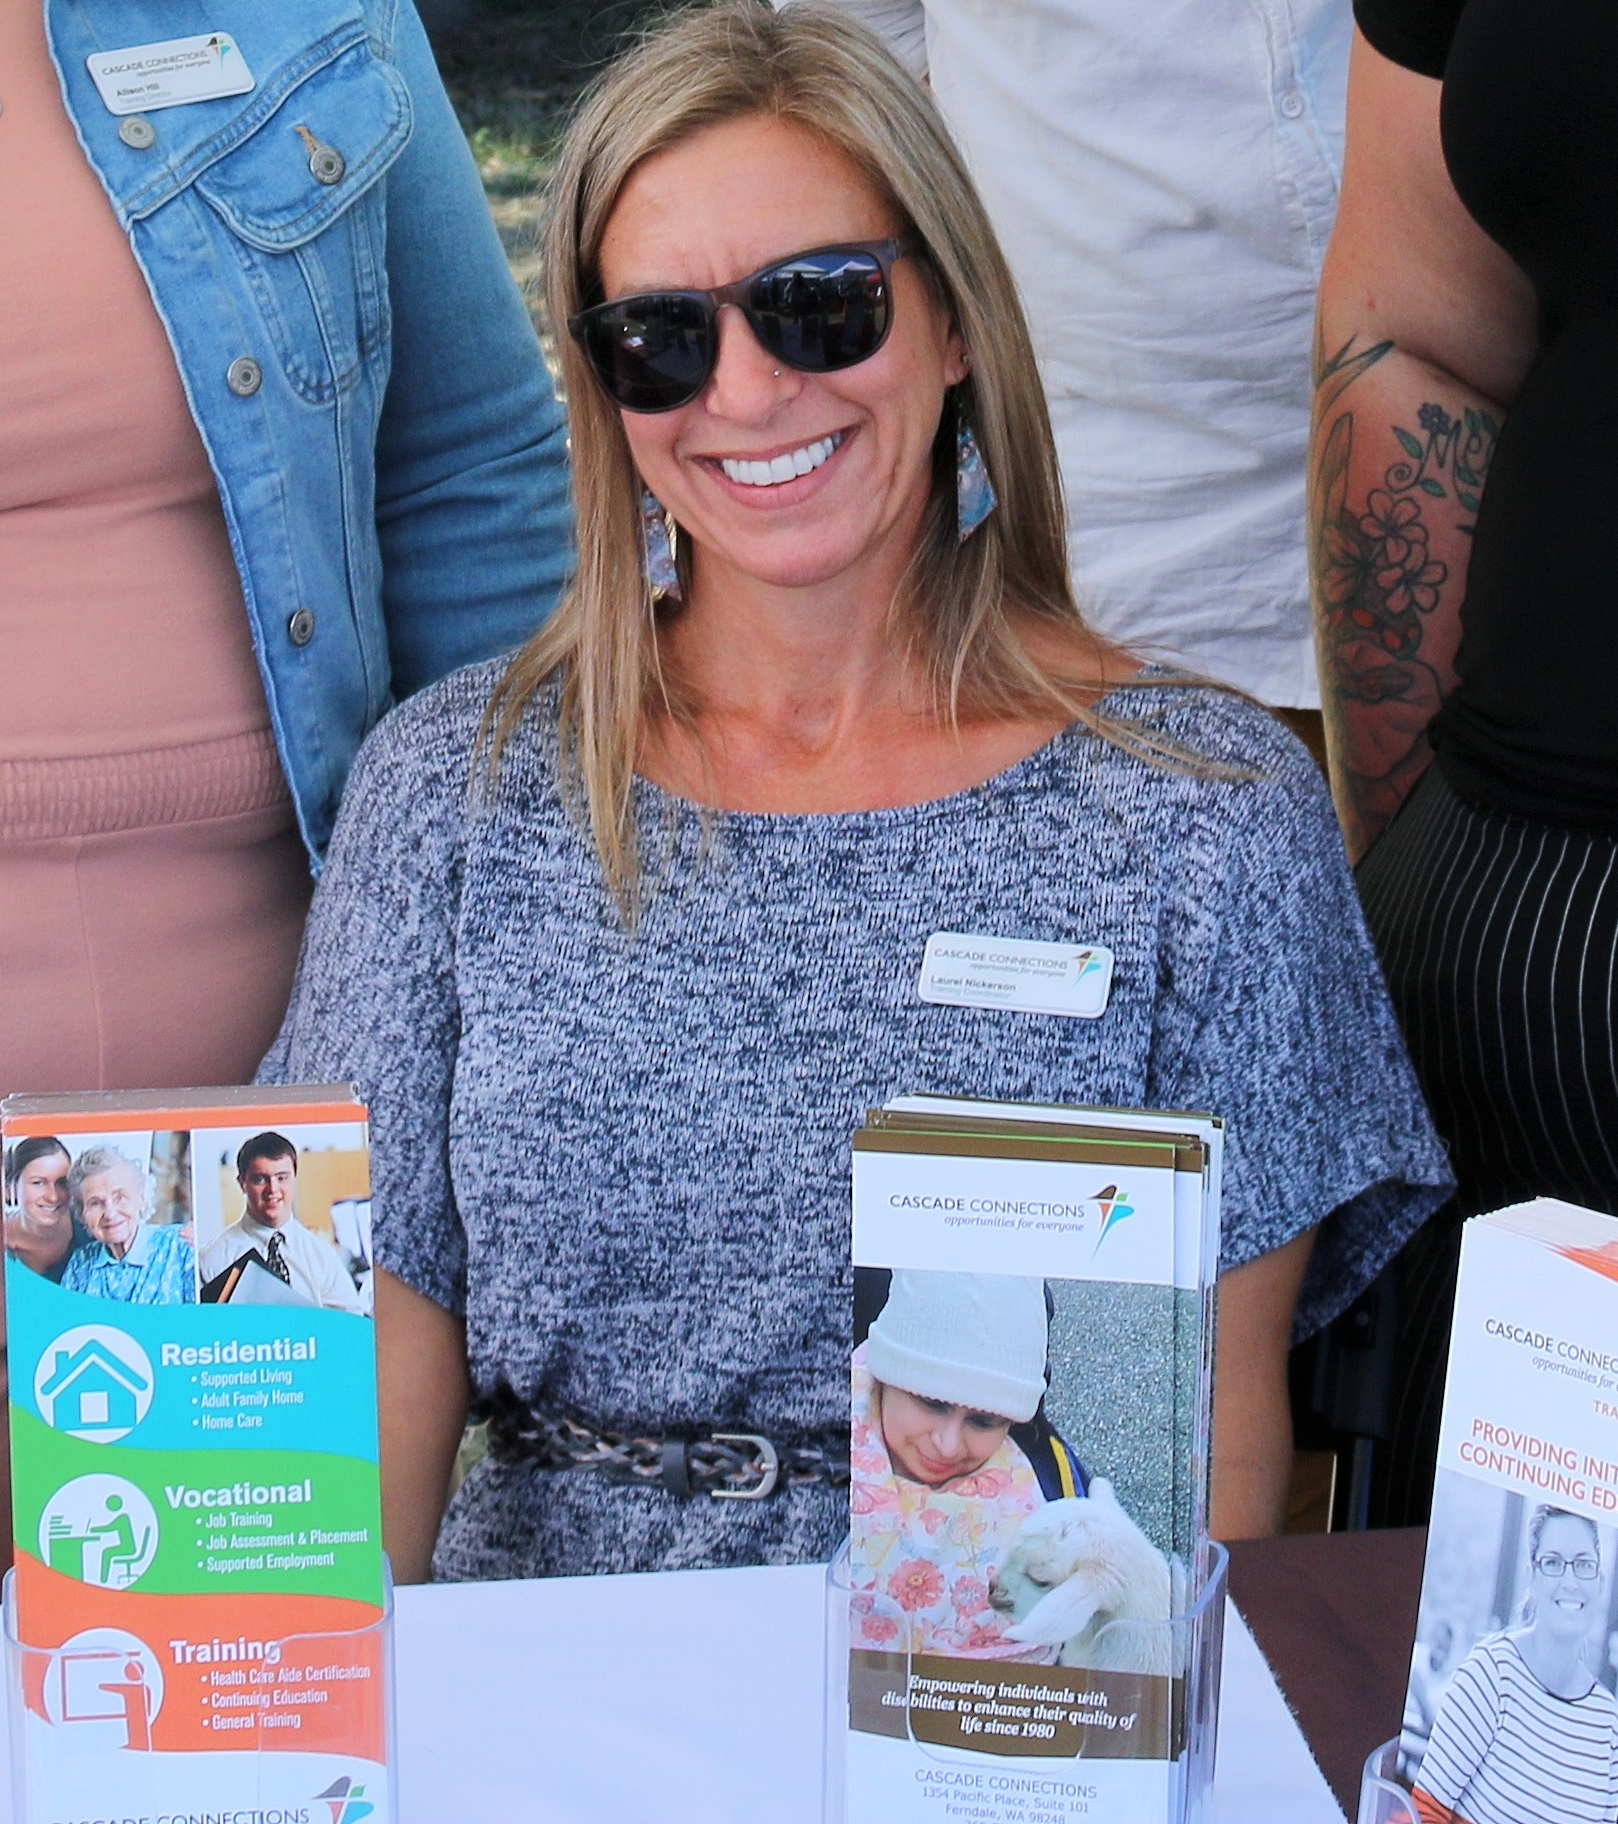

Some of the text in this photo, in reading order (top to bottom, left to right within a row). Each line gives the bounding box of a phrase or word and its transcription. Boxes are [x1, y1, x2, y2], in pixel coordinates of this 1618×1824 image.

[934, 948, 1068, 969] CASCADE CONNECTIONS
[931, 975, 963, 987] Laurel
[965, 978, 1017, 992] Nickerson
[889, 1194, 1084, 1217] CASCADE CONNECTIONS
[944, 1215, 1084, 1232] opportunities for everyone
[1485, 1318, 1553, 1353] CASCADE
[162, 1336, 315, 1365] Residential
[200, 1368, 292, 1388] Supported Living
[1532, 1356, 1598, 1384] opportunities
[1598, 1373, 1615, 1388] for
[201, 1389, 303, 1407] Adult Family Home
[202, 1412, 262, 1429] Home Care
[1472, 1418, 1576, 1470] PROVIDING
[1460, 1441, 1585, 1500] CONTINUING
[164, 1479, 311, 1508] Vocational
[205, 1511, 272, 1528] Job Training
[205, 1528, 367, 1550] Job Assessment & Placement
[207, 1551, 333, 1573] Supported Employment
[169, 1637, 280, 1663] Training
[210, 1665, 370, 1685] Health Care Aide Certification
[211, 1688, 327, 1707] Continuing Education
[910, 1675, 1106, 1706] Empowering individuals with
[212, 1712, 300, 1729] General Training
[881, 1690, 1136, 1730] disabilities to enhance their quality of
[960, 1715, 1054, 1738] life since 1980
[914, 1770, 1096, 1798] CASCADE CONNECTIONS
[923, 1786, 1088, 1813] 1354 Pacific Place, Suite 101
[945, 1803, 1065, 1824] Ferndale, WA 98248
